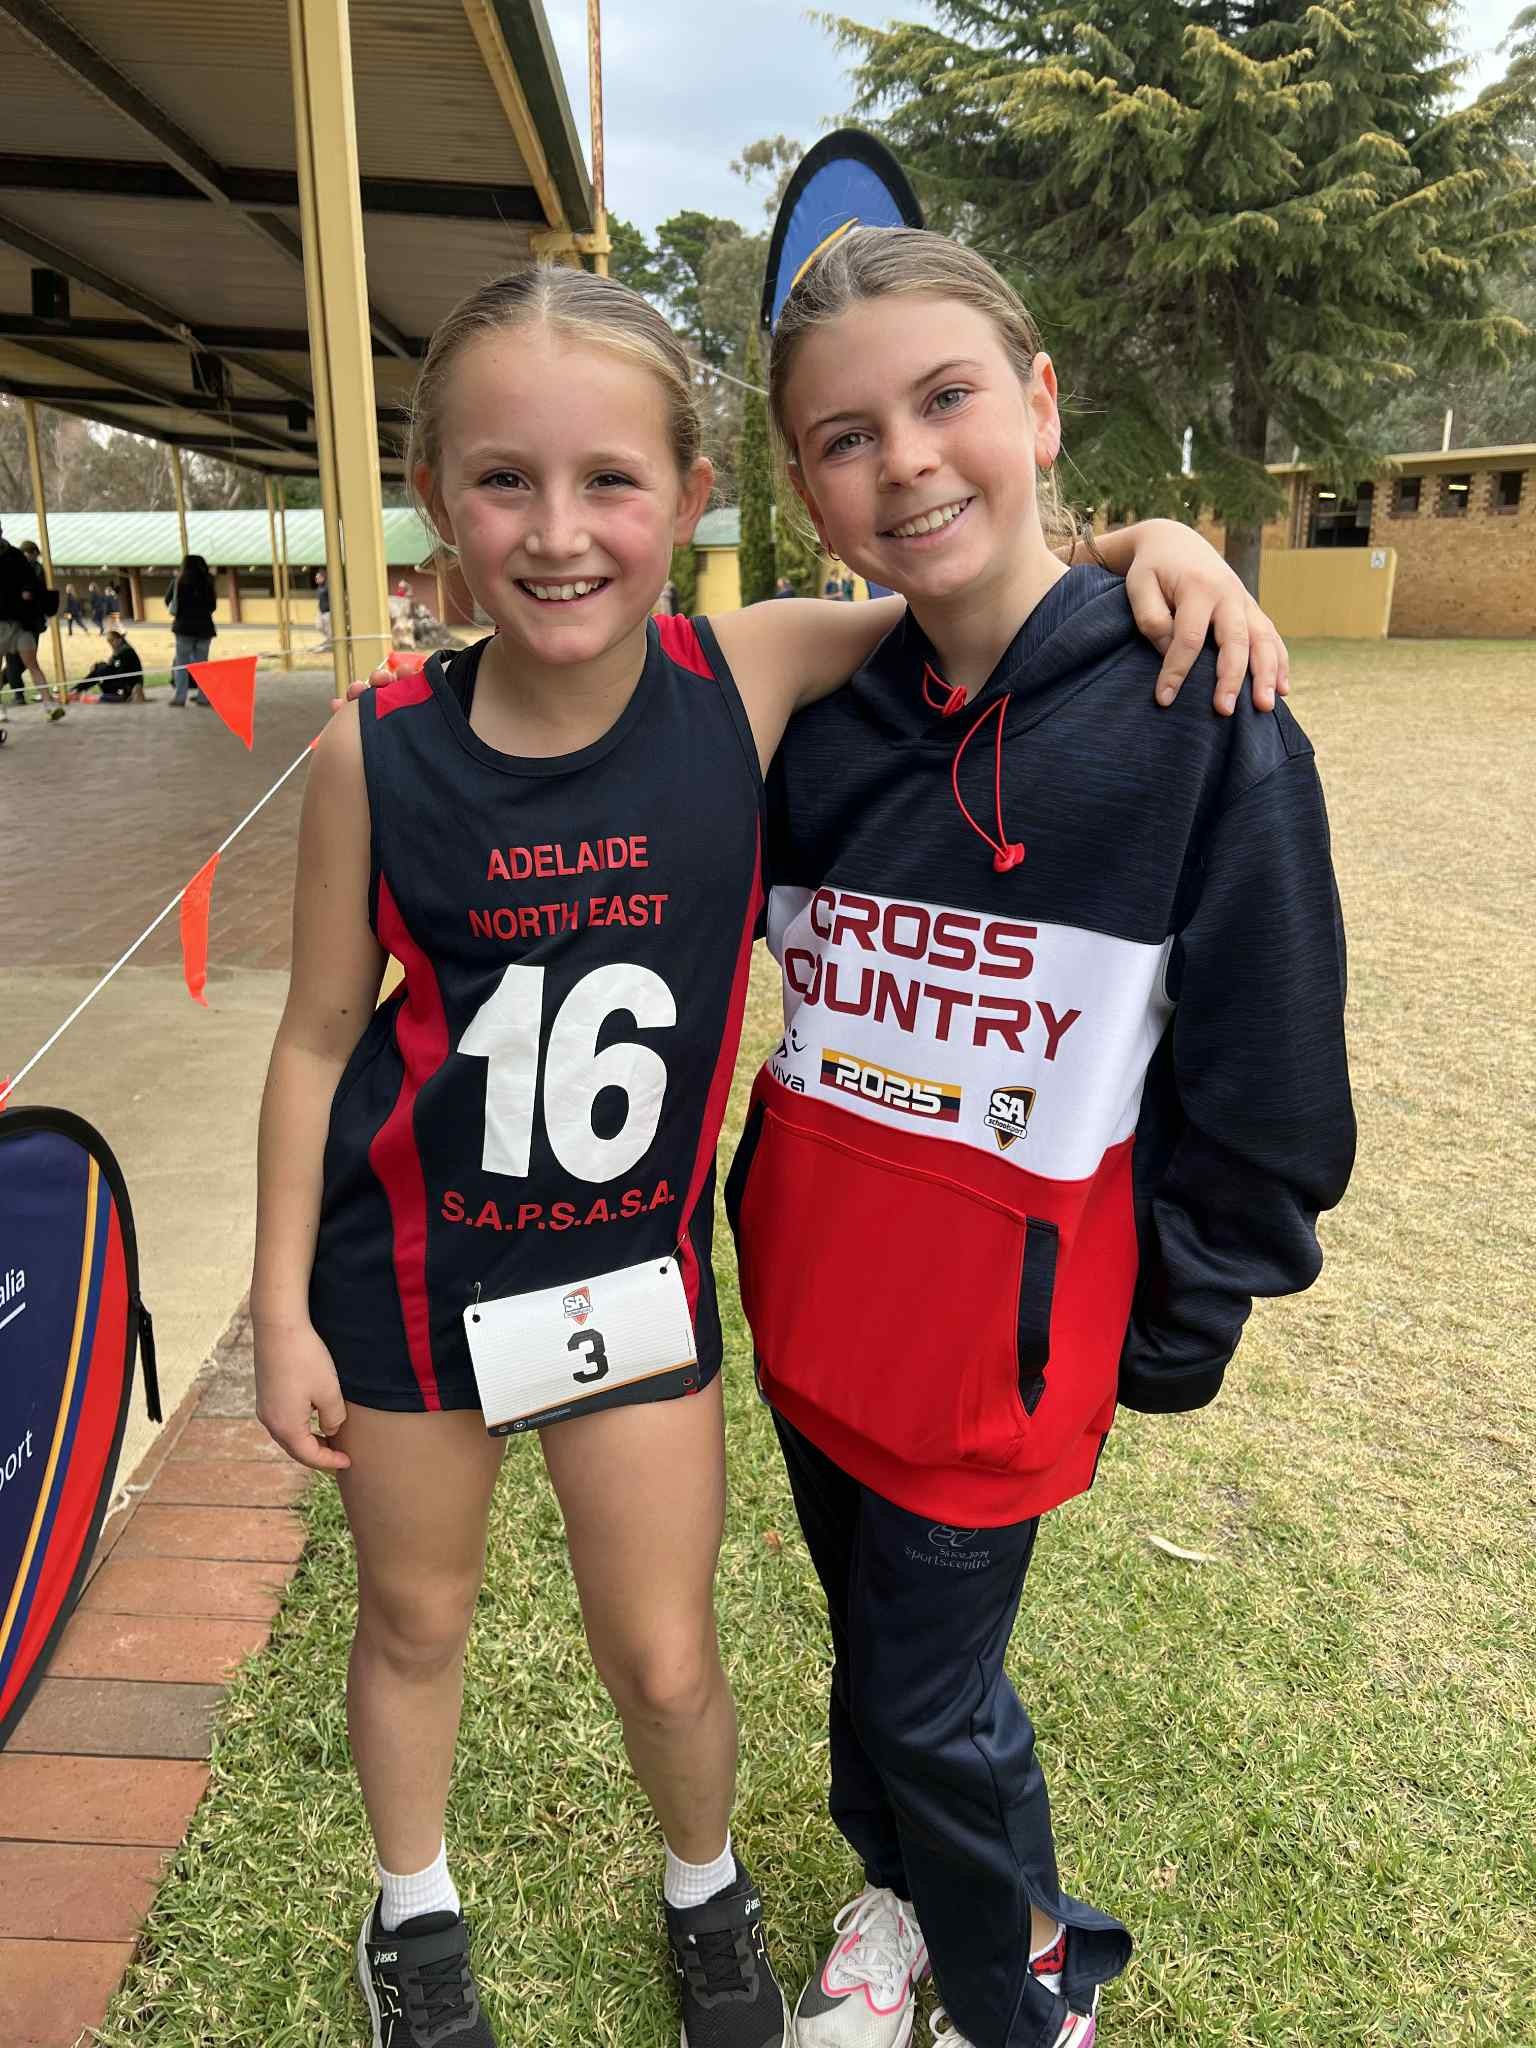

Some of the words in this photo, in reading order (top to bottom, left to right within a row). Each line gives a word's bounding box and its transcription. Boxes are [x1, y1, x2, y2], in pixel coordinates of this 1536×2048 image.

[487, 835, 649, 881] ADELAIDE
[468, 901, 578, 941] NORTH
[588, 894, 669, 927] EAST
[810, 887, 1038, 980] CROSS
[457, 962, 677, 1184] 16
[836, 1056, 942, 1115] 2025
[990, 1092, 1026, 1127] SA
[441, 1179, 676, 1232] S.A.P.S.A.S.A.
[567, 1328, 609, 1384] 3
